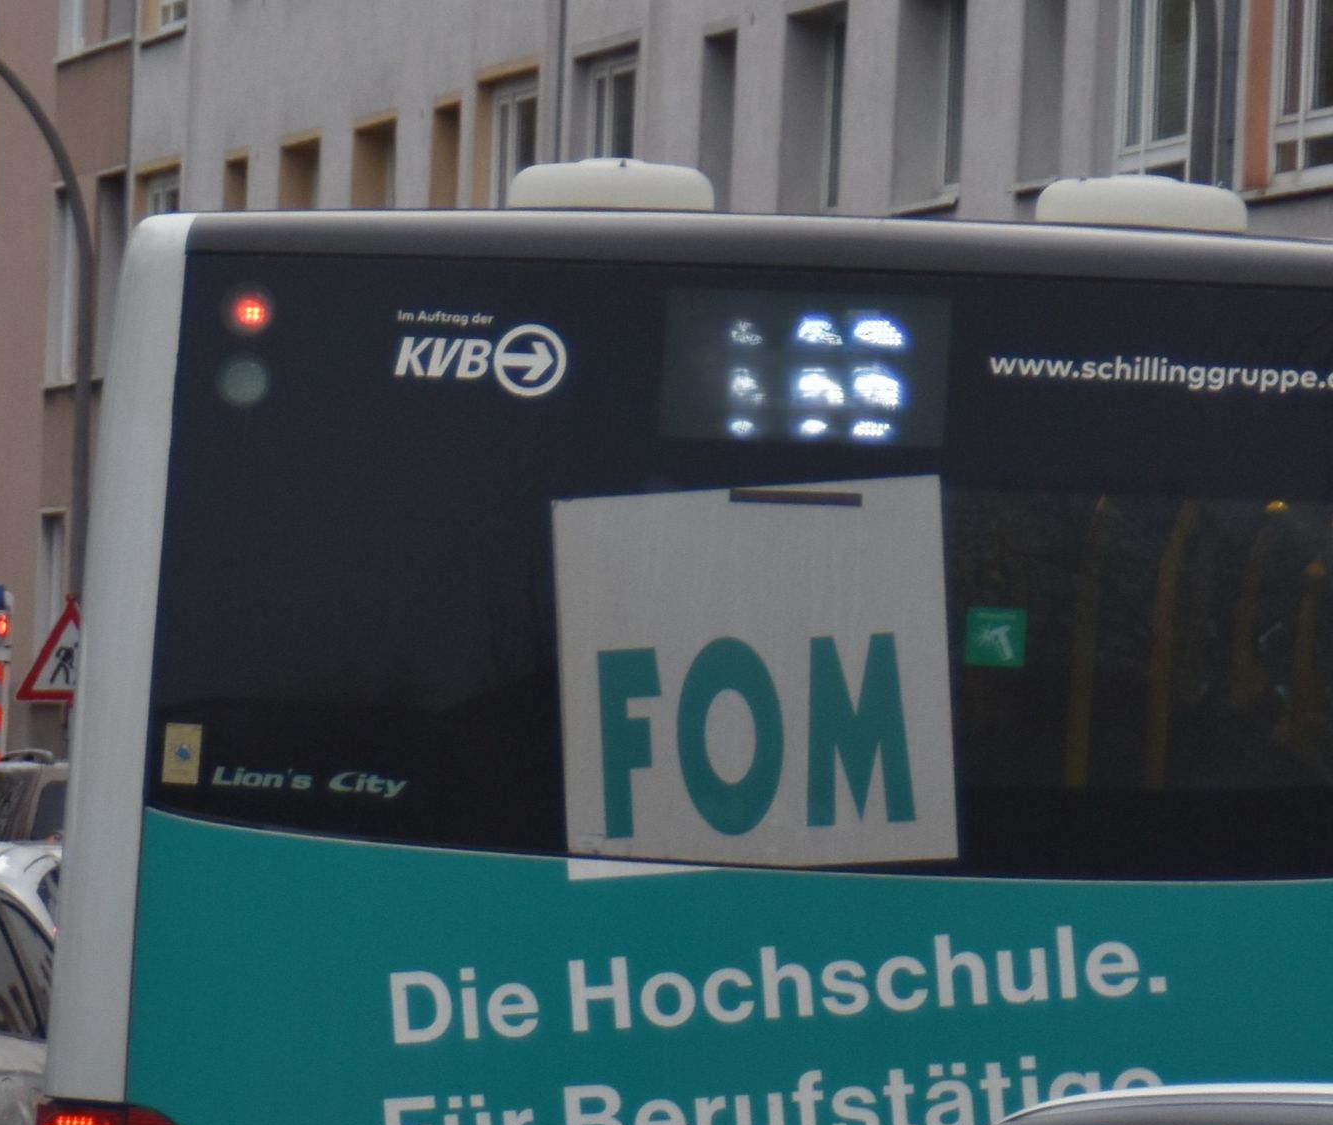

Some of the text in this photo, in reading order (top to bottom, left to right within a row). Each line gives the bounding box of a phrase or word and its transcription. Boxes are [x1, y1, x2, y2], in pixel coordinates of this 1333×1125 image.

[397, 310, 494, 326] Im Auftrag der
[394, 336, 492, 379] KVB
[597, 632, 917, 839] FOM
[212, 766, 408, 798] Lion's City
[389, 925, 1167, 1045] Die Hochschule.
